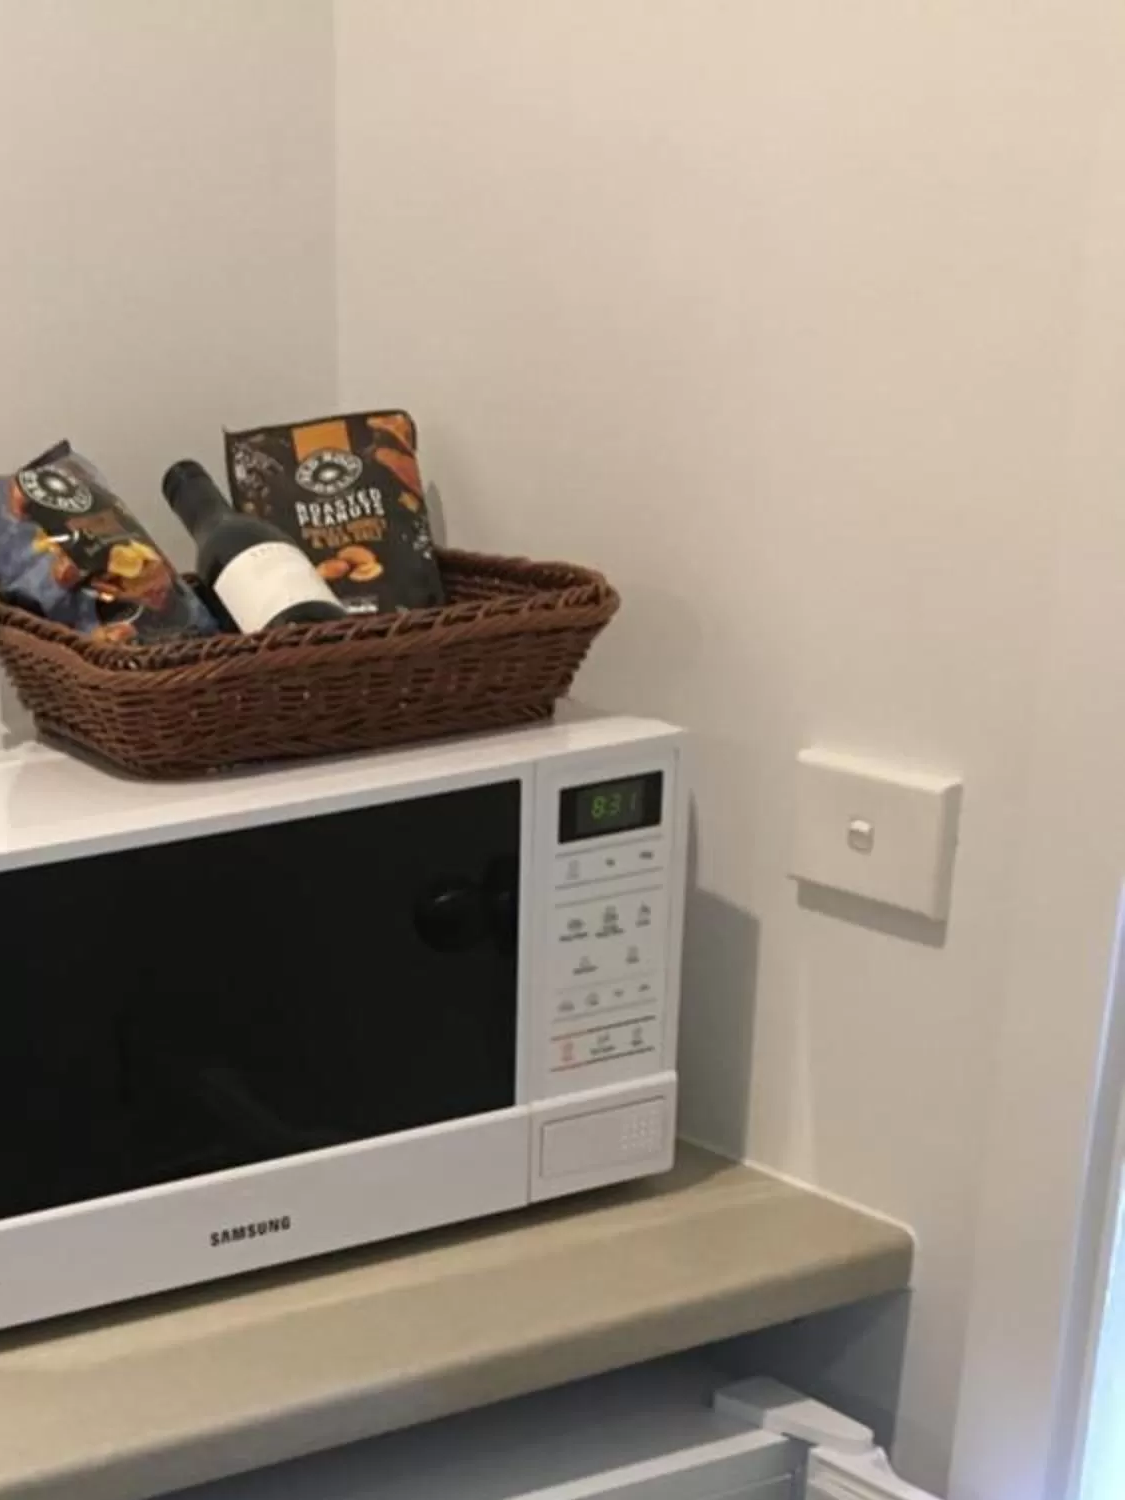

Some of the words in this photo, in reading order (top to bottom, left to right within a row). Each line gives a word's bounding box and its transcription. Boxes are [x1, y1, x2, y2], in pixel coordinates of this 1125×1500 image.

[295, 487, 382, 516] ROASTED
[298, 501, 385, 528] PEANUTS
[210, 1215, 291, 1248] SAMSUNG
